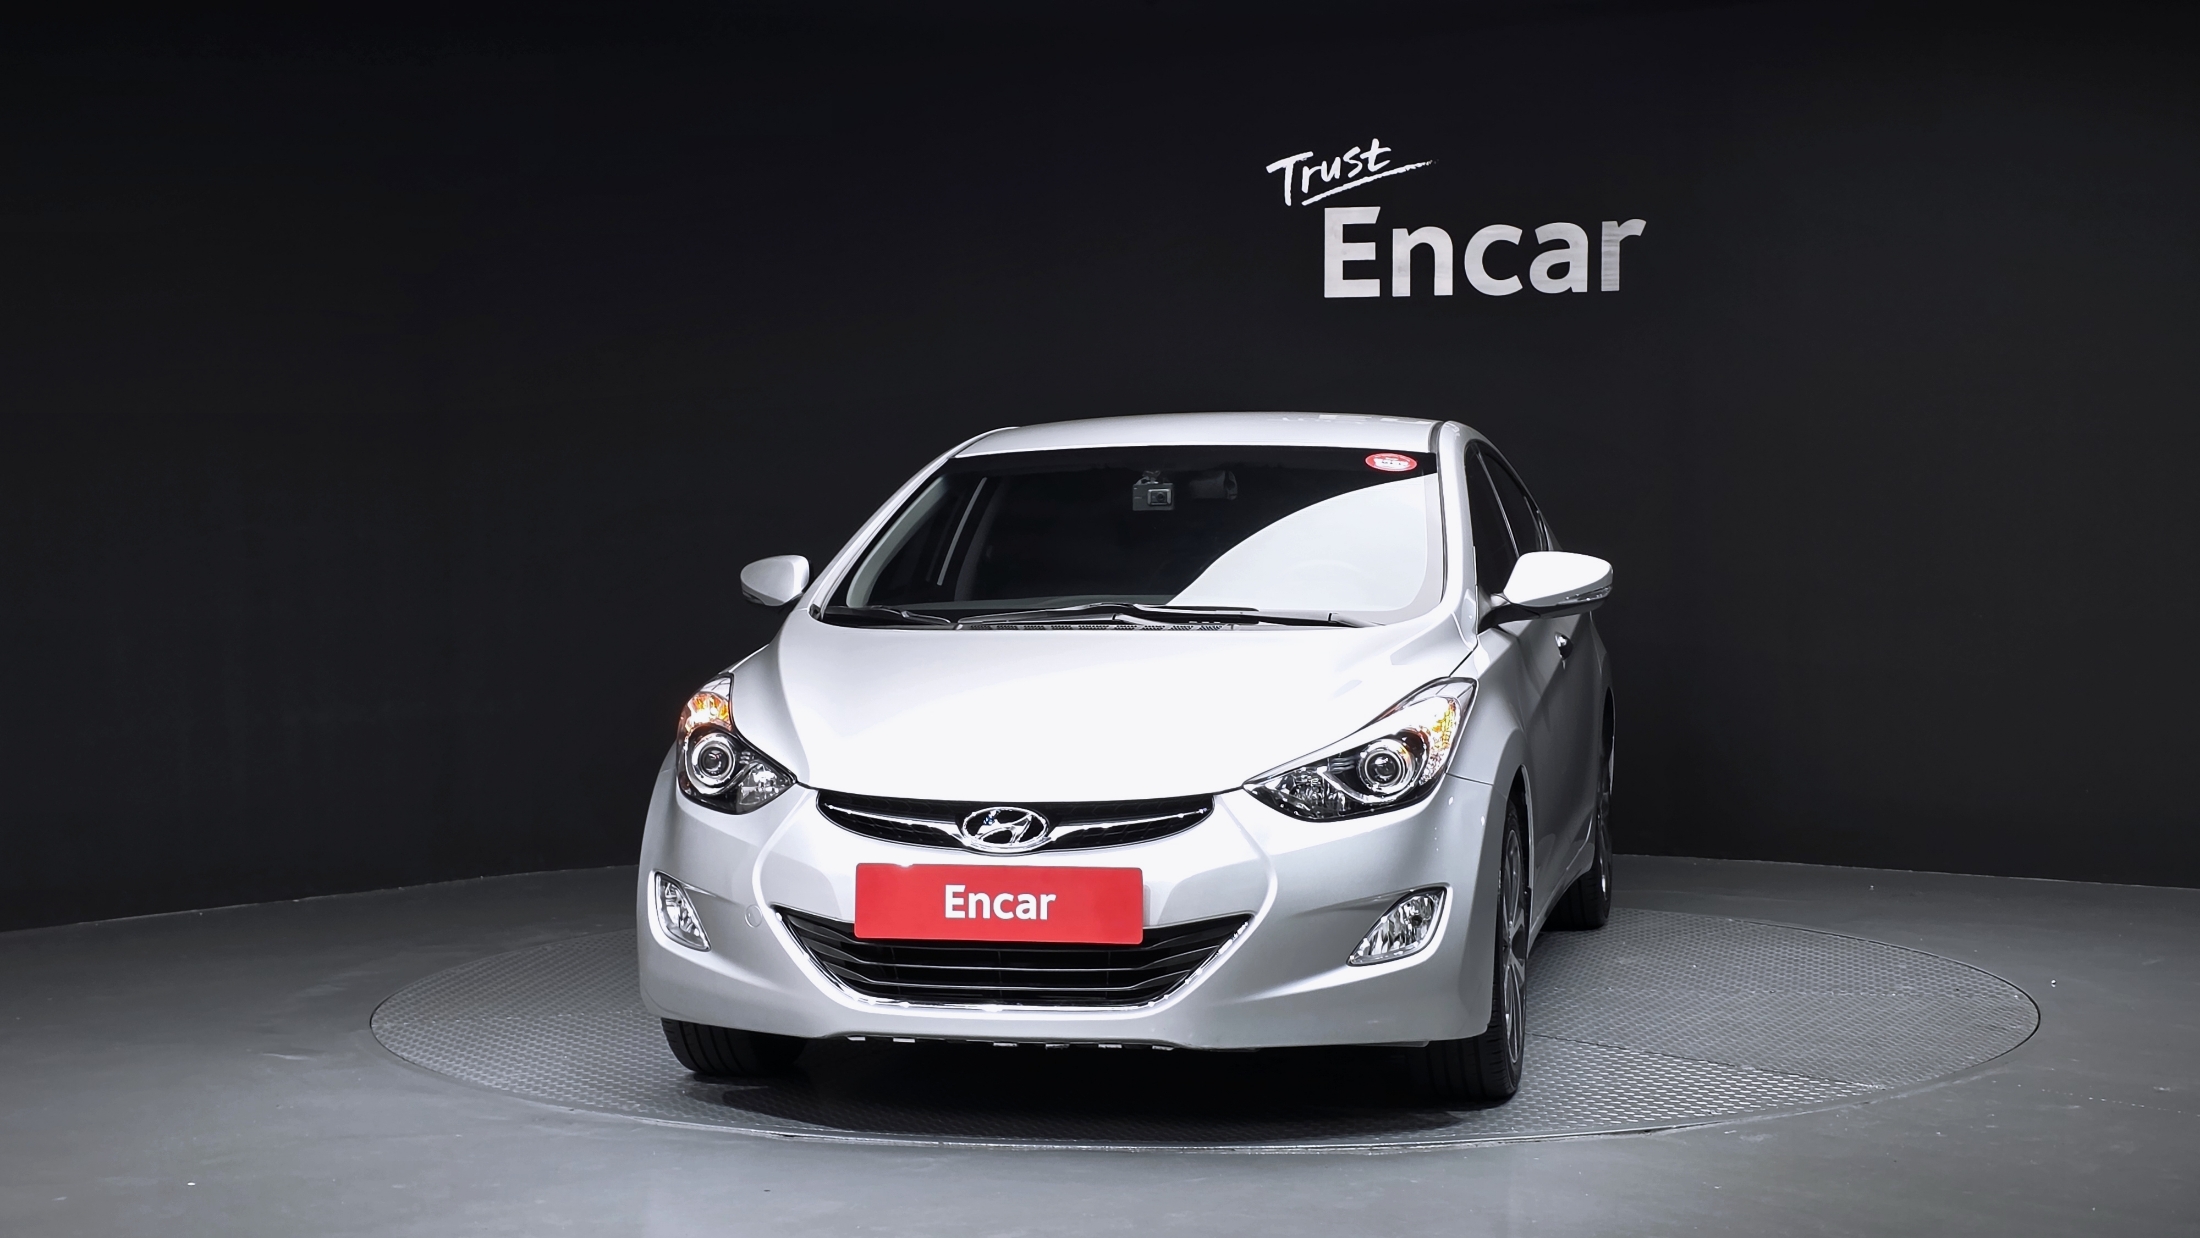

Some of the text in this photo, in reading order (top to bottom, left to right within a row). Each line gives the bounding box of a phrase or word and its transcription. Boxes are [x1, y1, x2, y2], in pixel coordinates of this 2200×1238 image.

[1266, 138, 1391, 206] Trust
[1324, 206, 1647, 298] Encar
[944, 884, 1057, 921] Encar
